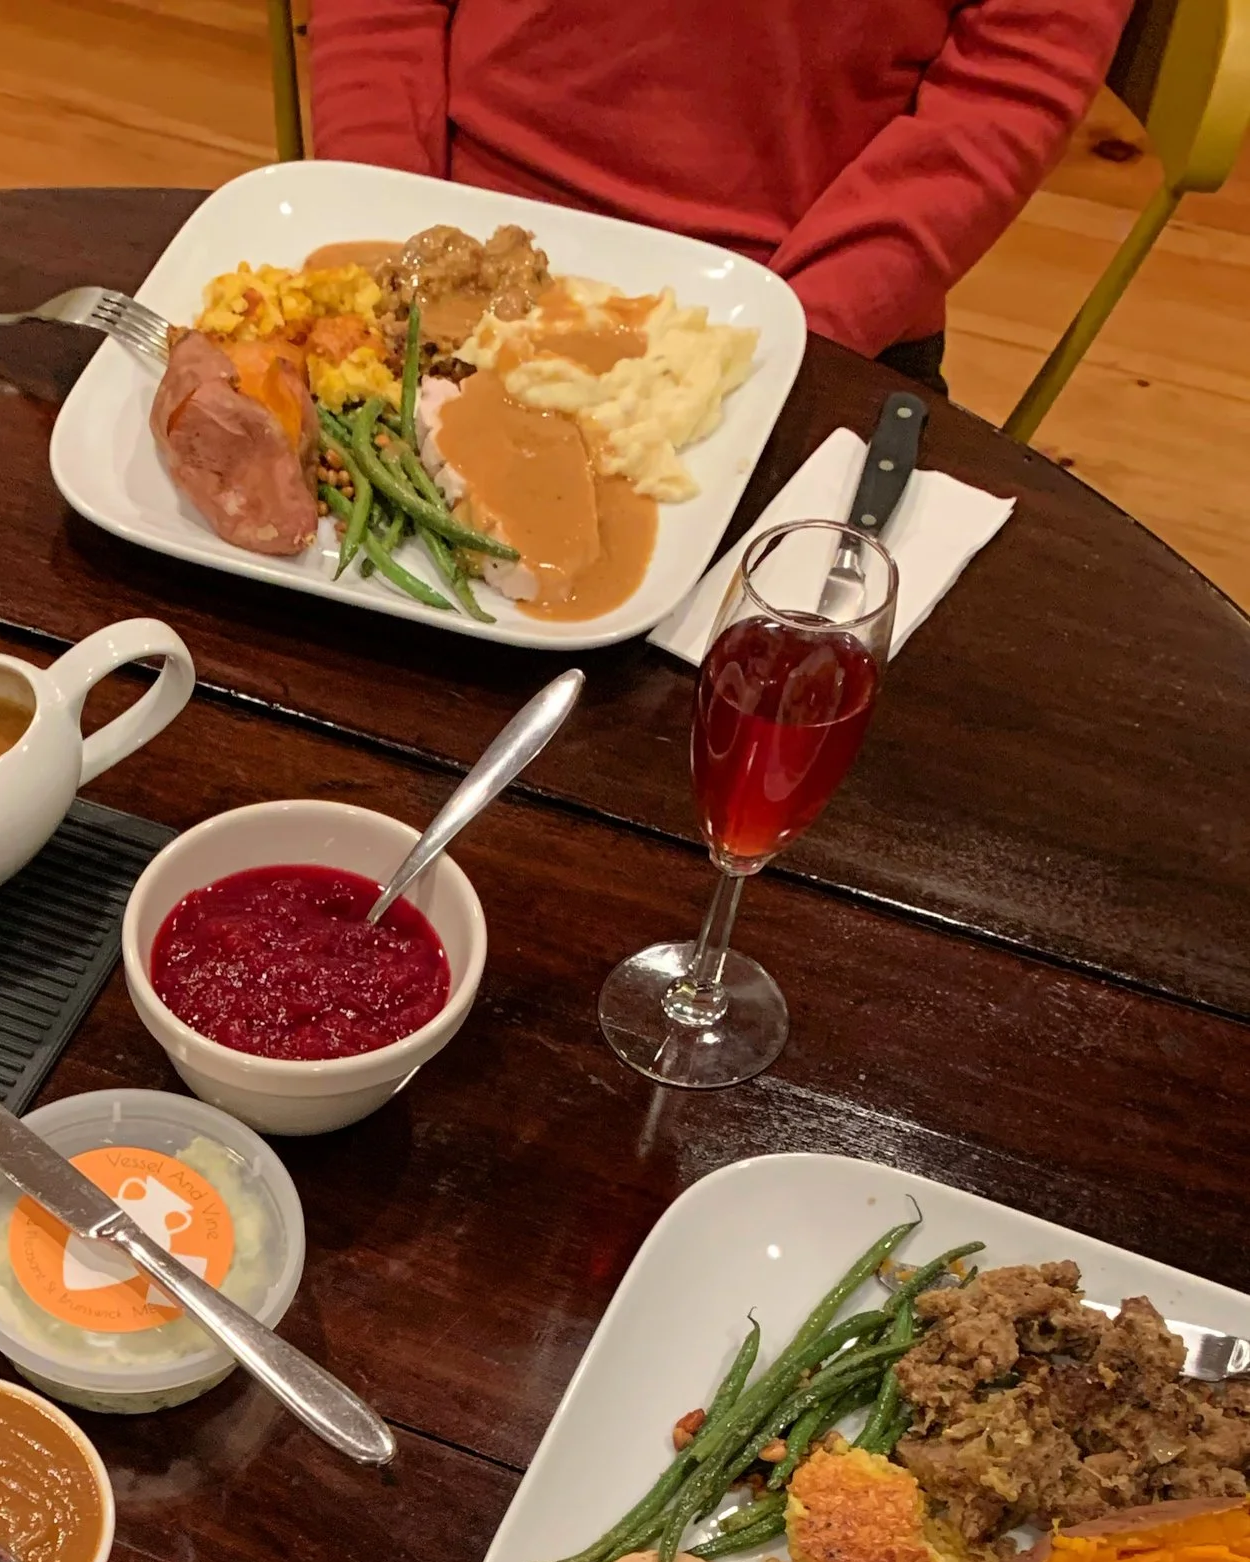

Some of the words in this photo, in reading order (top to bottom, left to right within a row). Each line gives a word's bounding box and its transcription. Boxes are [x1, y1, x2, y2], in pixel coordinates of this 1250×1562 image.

[106, 1151, 166, 1174] Vessel
[168, 1171, 209, 1201] And
[201, 1202, 222, 1241] Vine
[57, 1293, 121, 1320] Brunswick
